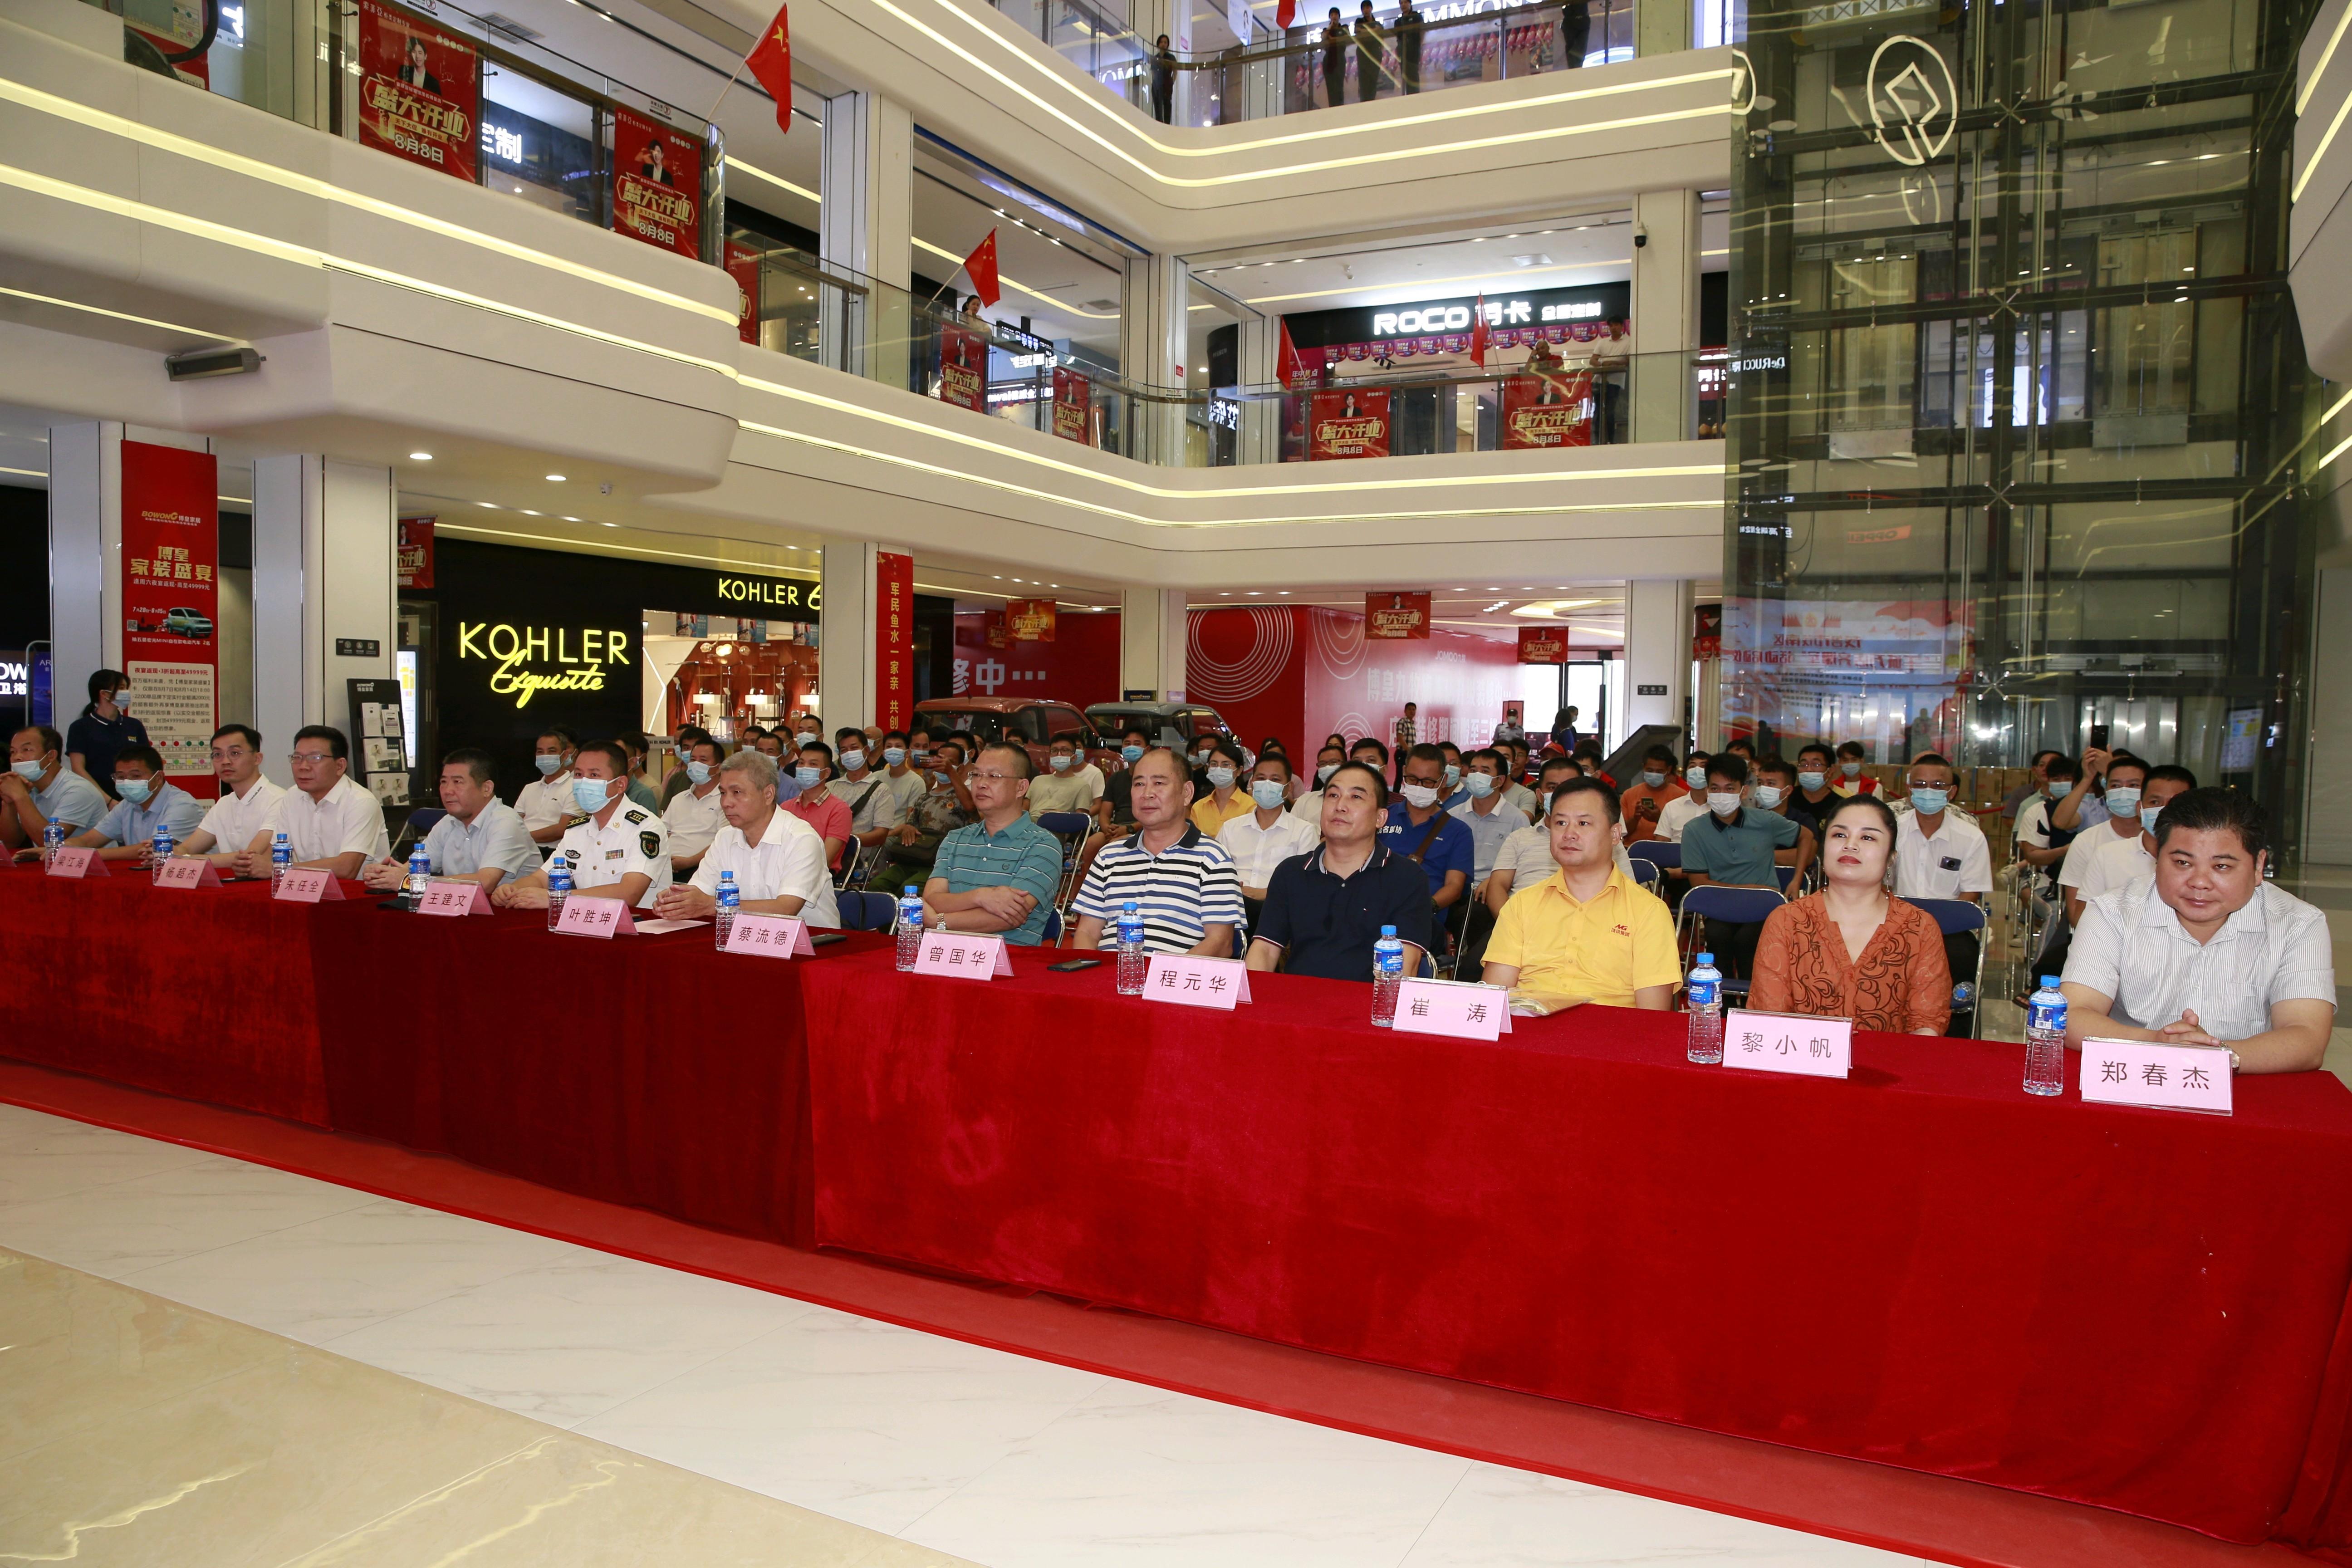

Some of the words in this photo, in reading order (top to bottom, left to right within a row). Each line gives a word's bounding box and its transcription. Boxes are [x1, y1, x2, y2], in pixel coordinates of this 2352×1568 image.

[372, 84, 464, 138] 盛大开业
[394, 134, 443, 164] 8月8日
[623, 181, 690, 222] 盛大开业
[638, 222, 675, 245] 8月8日
[1374, 307, 1470, 336] ROCO
[953, 393, 971, 407] 8月8日
[1515, 409, 1582, 427] 盛大开业
[1321, 422, 1380, 440] 盛大开业
[1533, 435, 1561, 444] 8月8日
[1337, 446, 1362, 455] 8月8日
[142, 511, 178, 520] BOWONG
[157, 546, 189, 562] 博皇
[130, 559, 213, 582] 家装盛宴
[719, 578, 798, 606] KOHLER
[460, 622, 630, 665] KOHLER
[890, 582, 900, 690] 军民鱼水一家亲
[1435, 650, 1458, 662] JOMOO
[490, 648, 607, 709] Exquisite
[889, 700, 899, 730] 共创
[166, 867, 197, 880] 杨超杰
[284, 879, 318, 892] 朱任全
[428, 893, 467, 906] 王建文
[569, 908, 612, 925] 叶胜坤
[738, 926, 789, 946] 蔡流德
[929, 946, 986, 966] 曾国华
[1160, 970, 1227, 994] 程元华
[1741, 1032, 1832, 1058] 黎小帆
[2101, 1060, 2210, 1090] 郑春杰
